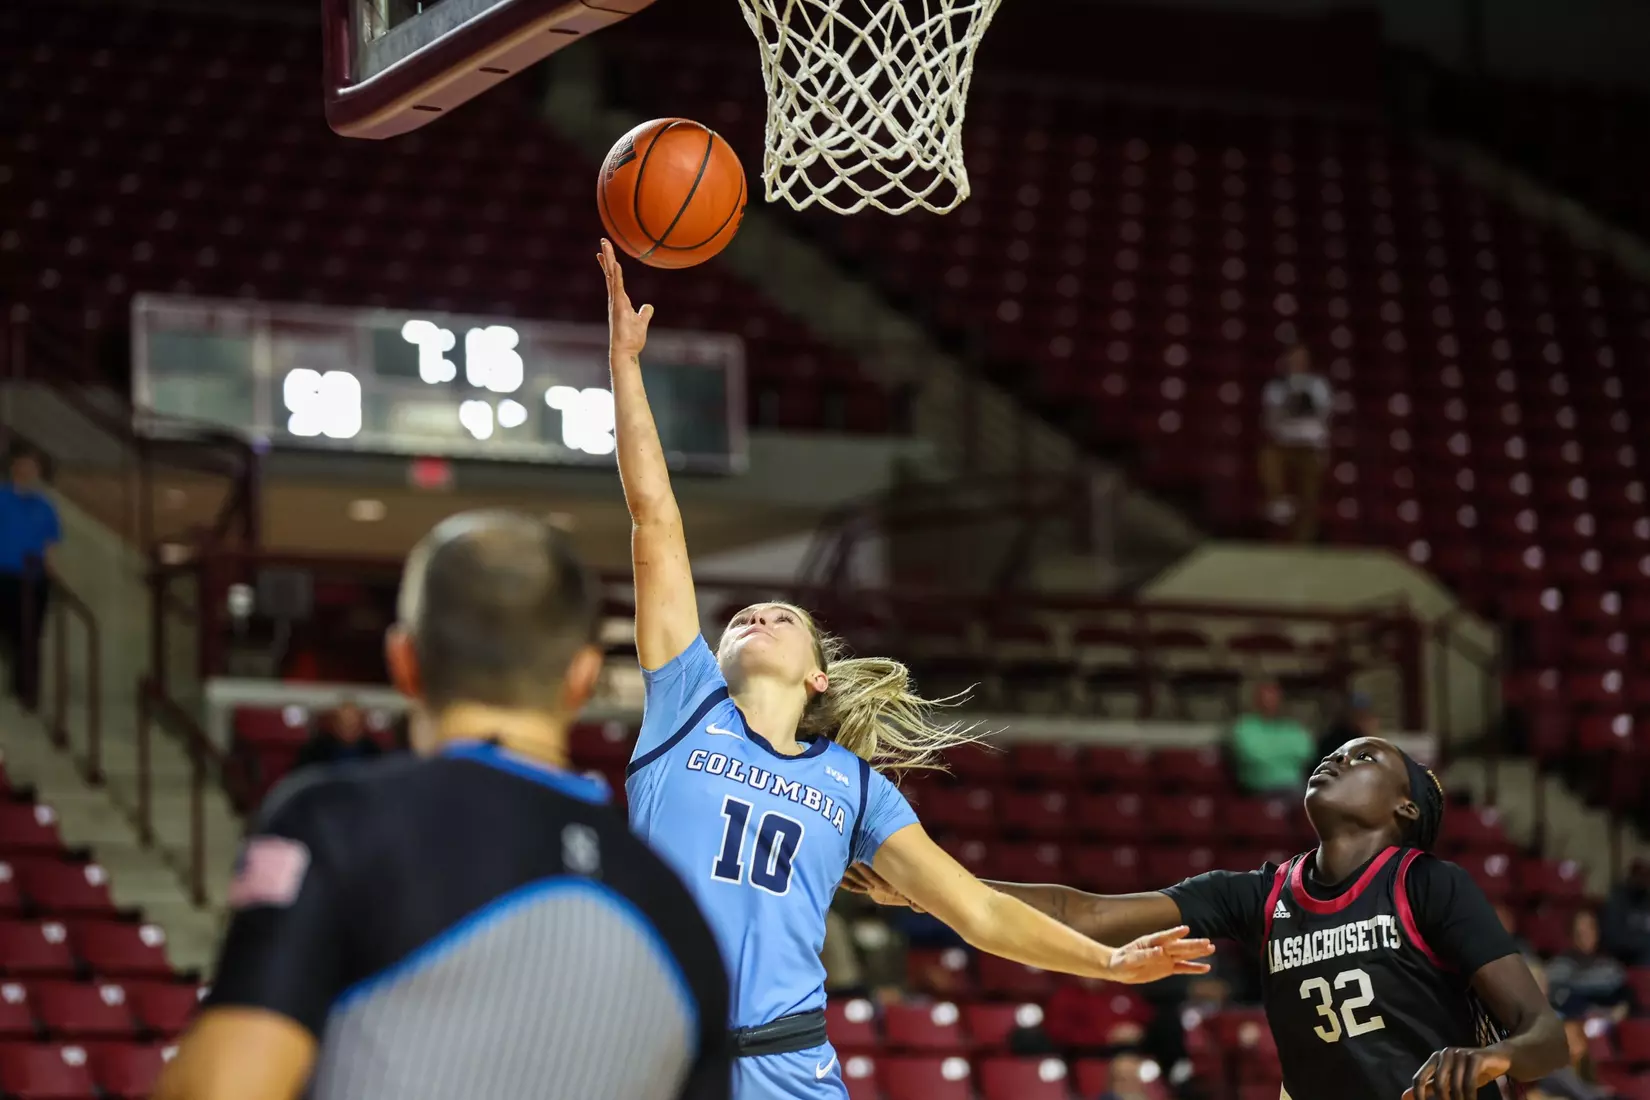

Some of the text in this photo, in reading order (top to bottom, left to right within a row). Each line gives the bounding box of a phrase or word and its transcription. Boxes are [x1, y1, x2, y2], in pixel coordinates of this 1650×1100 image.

[686, 749, 846, 836] COLUMBIA
[710, 794, 805, 896] 10
[1300, 968, 1386, 1043] 32
